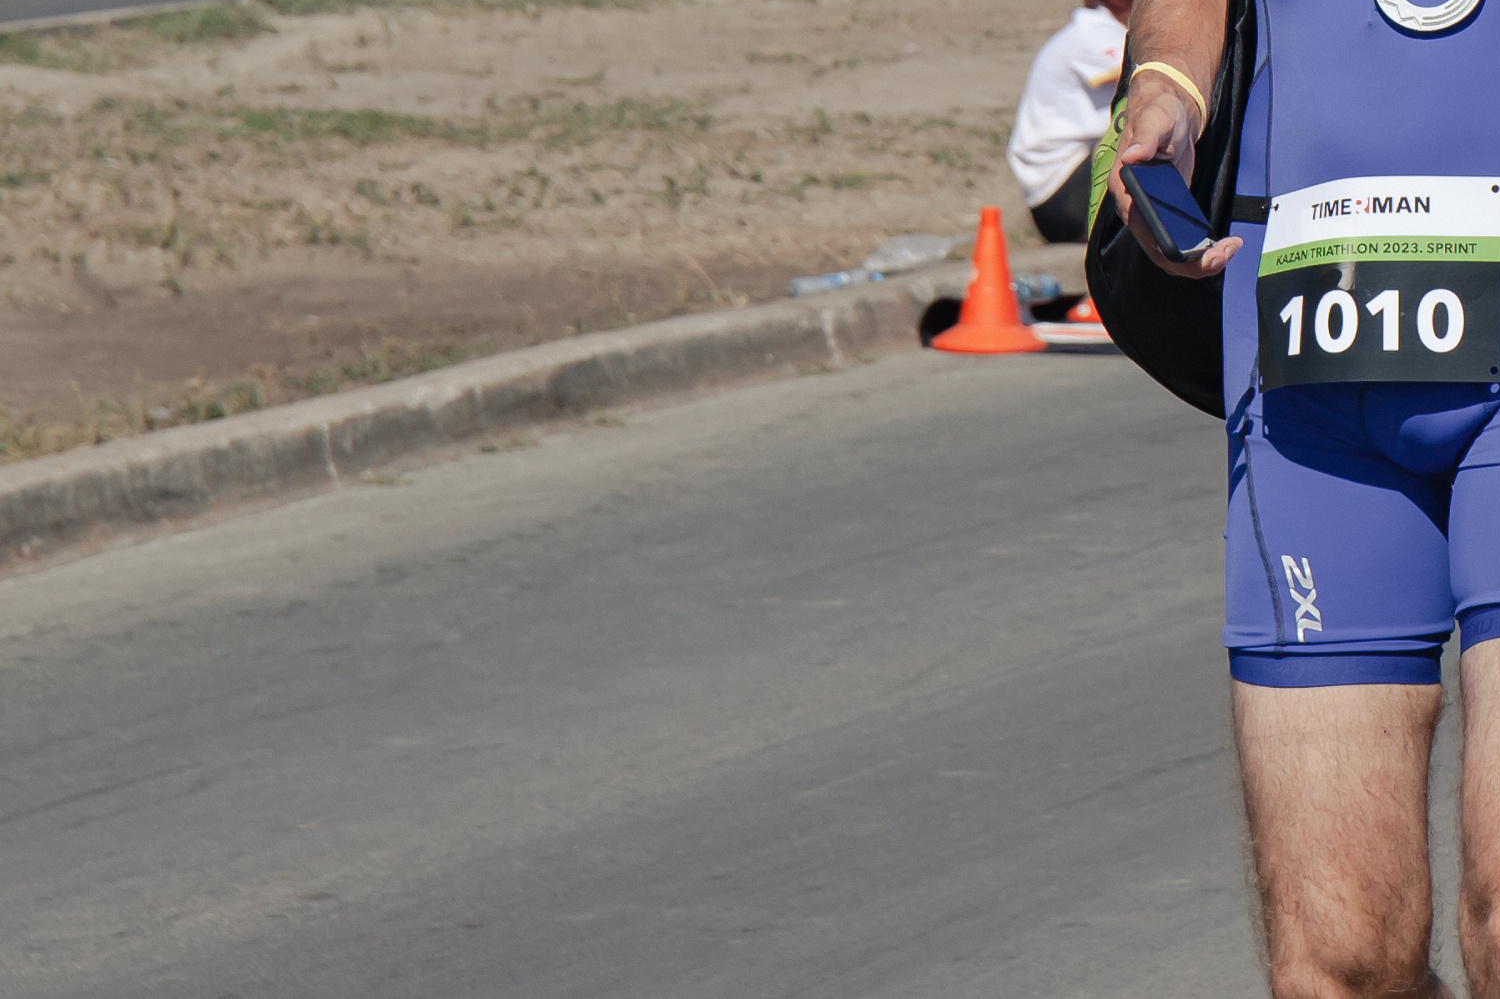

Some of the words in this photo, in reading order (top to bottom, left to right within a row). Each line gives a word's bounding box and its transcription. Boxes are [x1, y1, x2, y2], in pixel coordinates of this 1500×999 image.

[1275, 251, 1308, 266] KAZAN
[1310, 243, 1378, 259] TRIATHLON
[1382, 242, 1423, 254] 2023.
[1426, 242, 1477, 254] SPRINT
[1279, 288, 1465, 357] 1010
